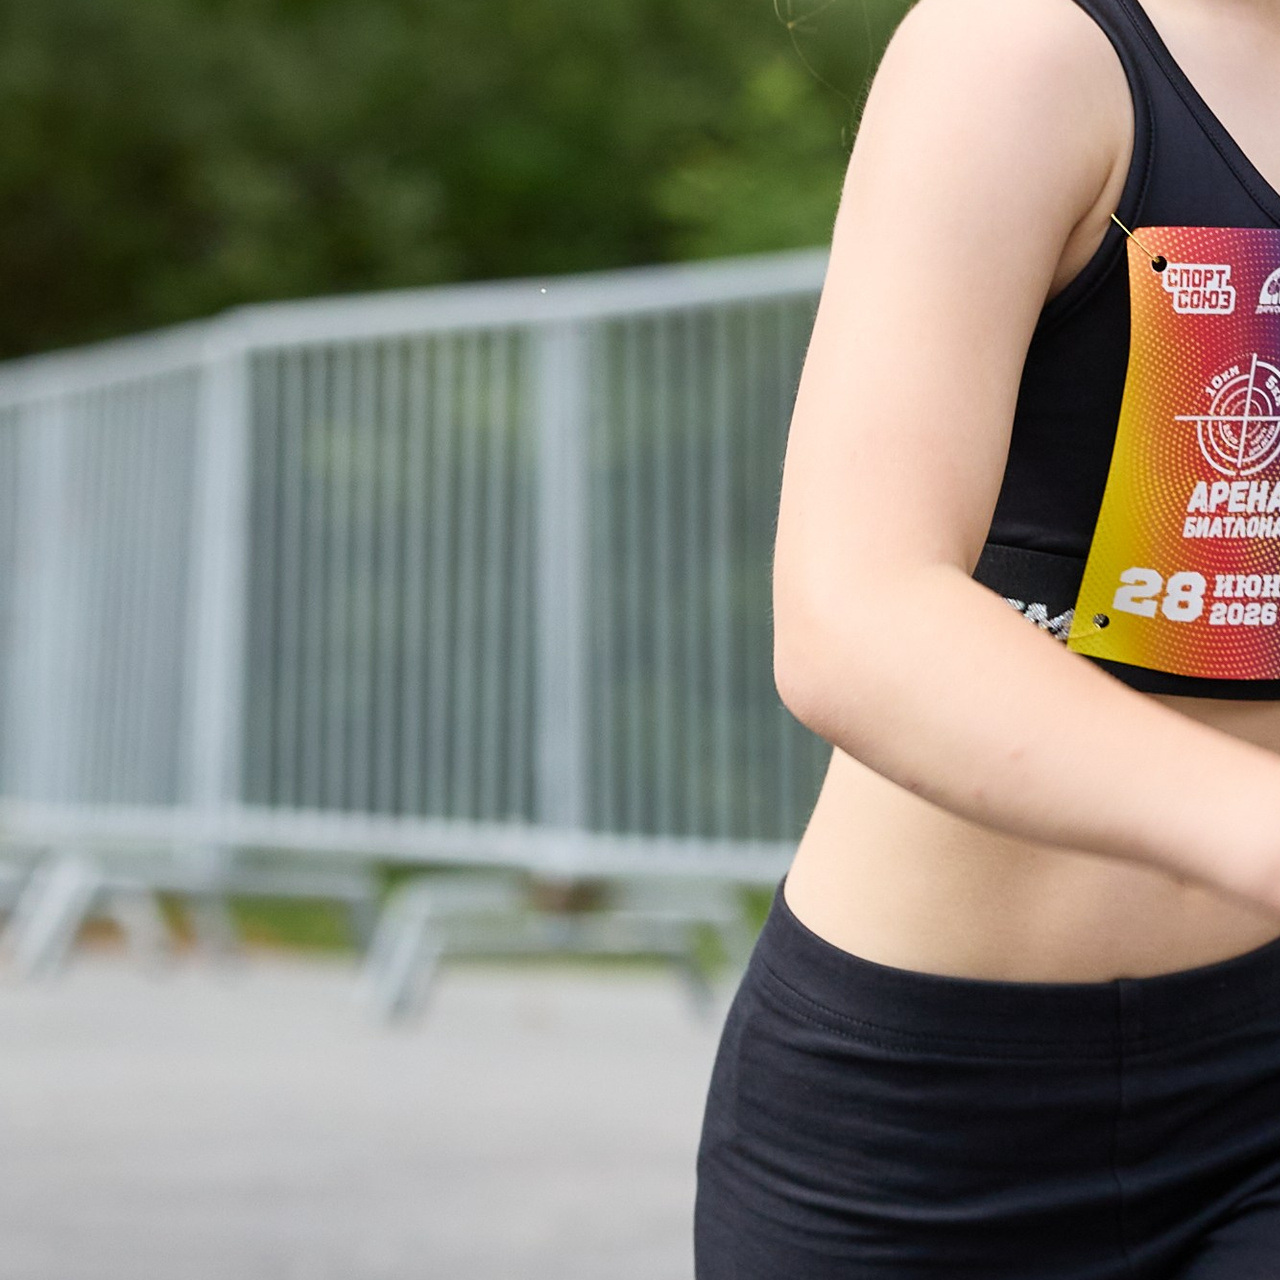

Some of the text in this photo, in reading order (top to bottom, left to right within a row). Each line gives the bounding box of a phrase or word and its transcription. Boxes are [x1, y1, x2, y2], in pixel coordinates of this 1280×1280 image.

[1178, 290, 1232, 309] СОЮЗ
[1112, 566, 1207, 622] 28
[1209, 602, 1278, 626] 2026
